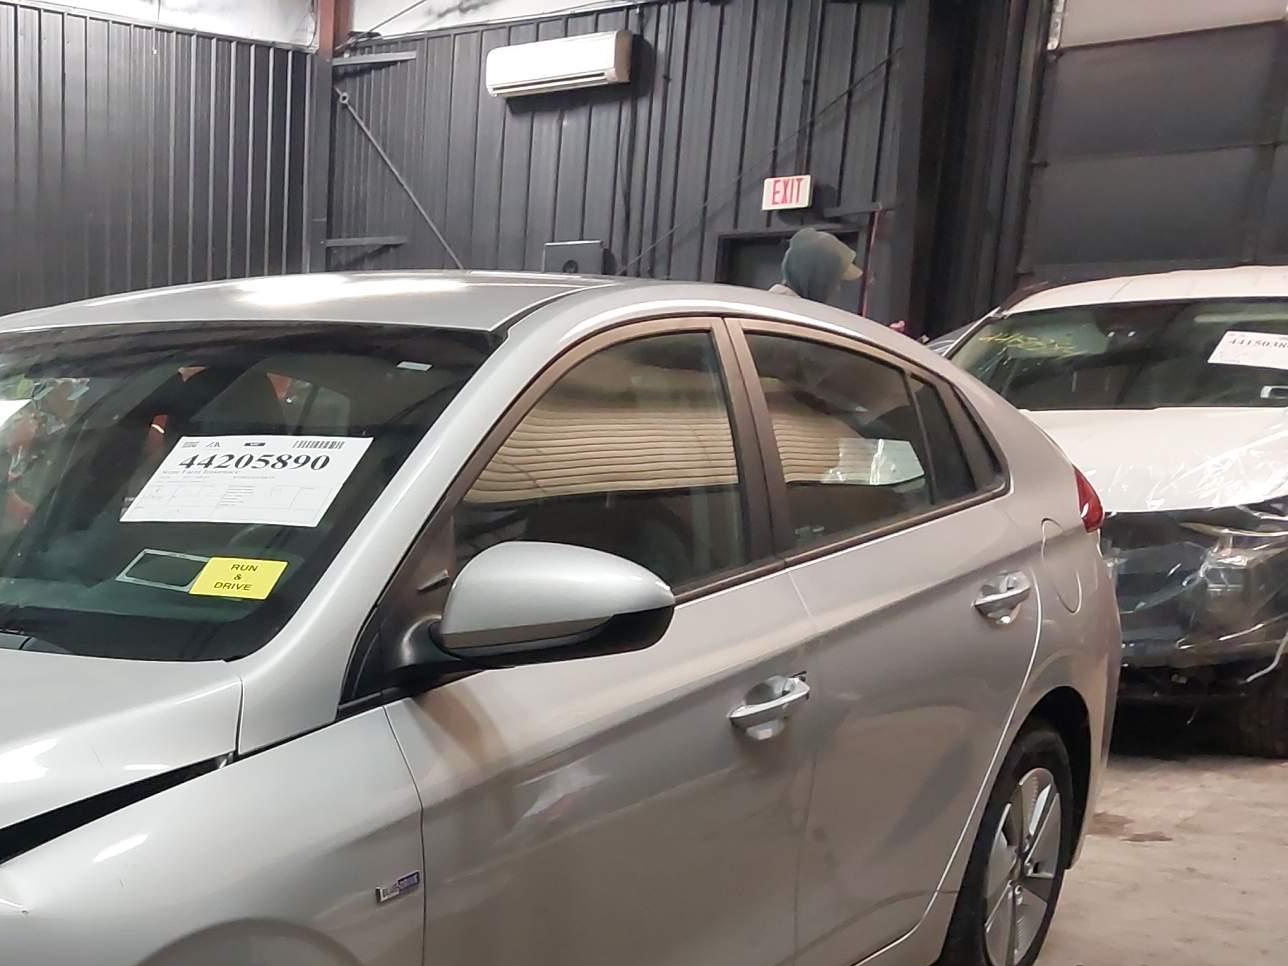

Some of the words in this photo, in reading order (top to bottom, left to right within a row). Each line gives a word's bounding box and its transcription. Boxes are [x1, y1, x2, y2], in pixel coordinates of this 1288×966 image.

[772, 178, 803, 205] EXIT
[179, 453, 331, 471] 44205890
[231, 564, 258, 572] RUN
[233, 573, 242, 581] &
[214, 581, 253, 591] DRIVE
